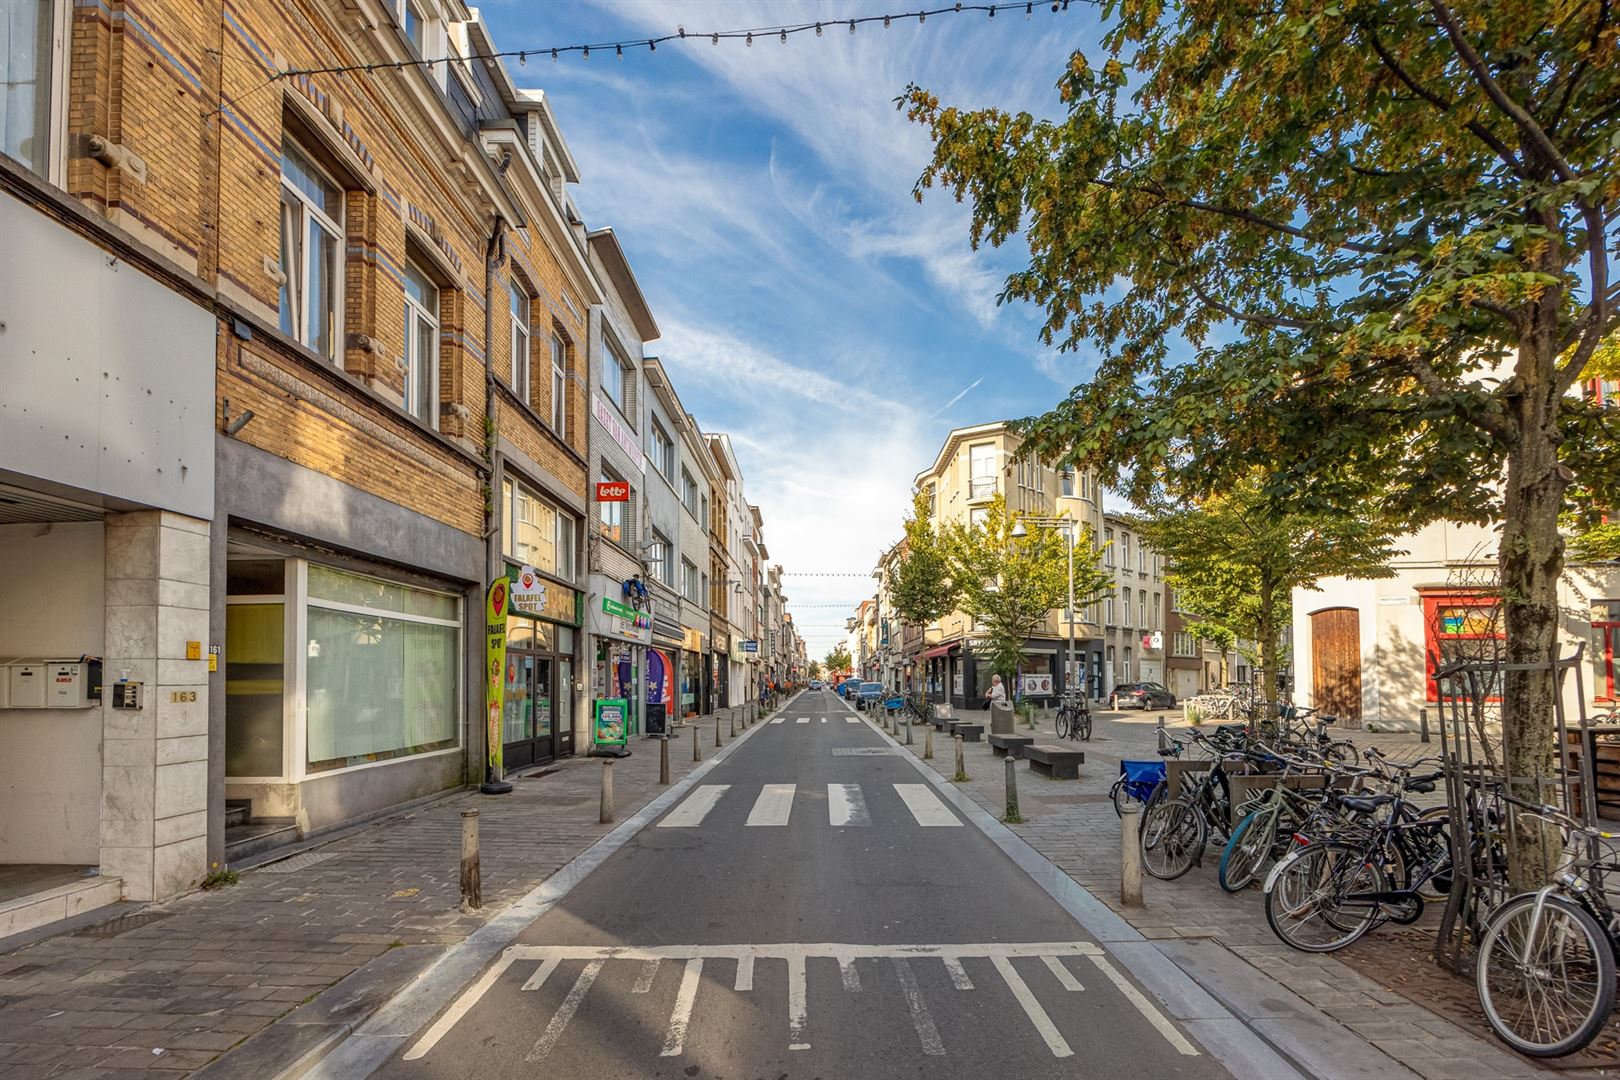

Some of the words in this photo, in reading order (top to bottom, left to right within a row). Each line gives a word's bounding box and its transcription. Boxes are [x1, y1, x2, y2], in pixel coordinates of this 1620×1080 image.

[600, 485, 626, 496] Lotto
[514, 594, 542, 602] FALAFEL
[518, 602, 537, 611] SPOT
[487, 623, 506, 635] FALAFEL
[491, 638, 502, 649] SPOT
[210, 645, 221, 654] 161
[172, 691, 197, 702] 163
